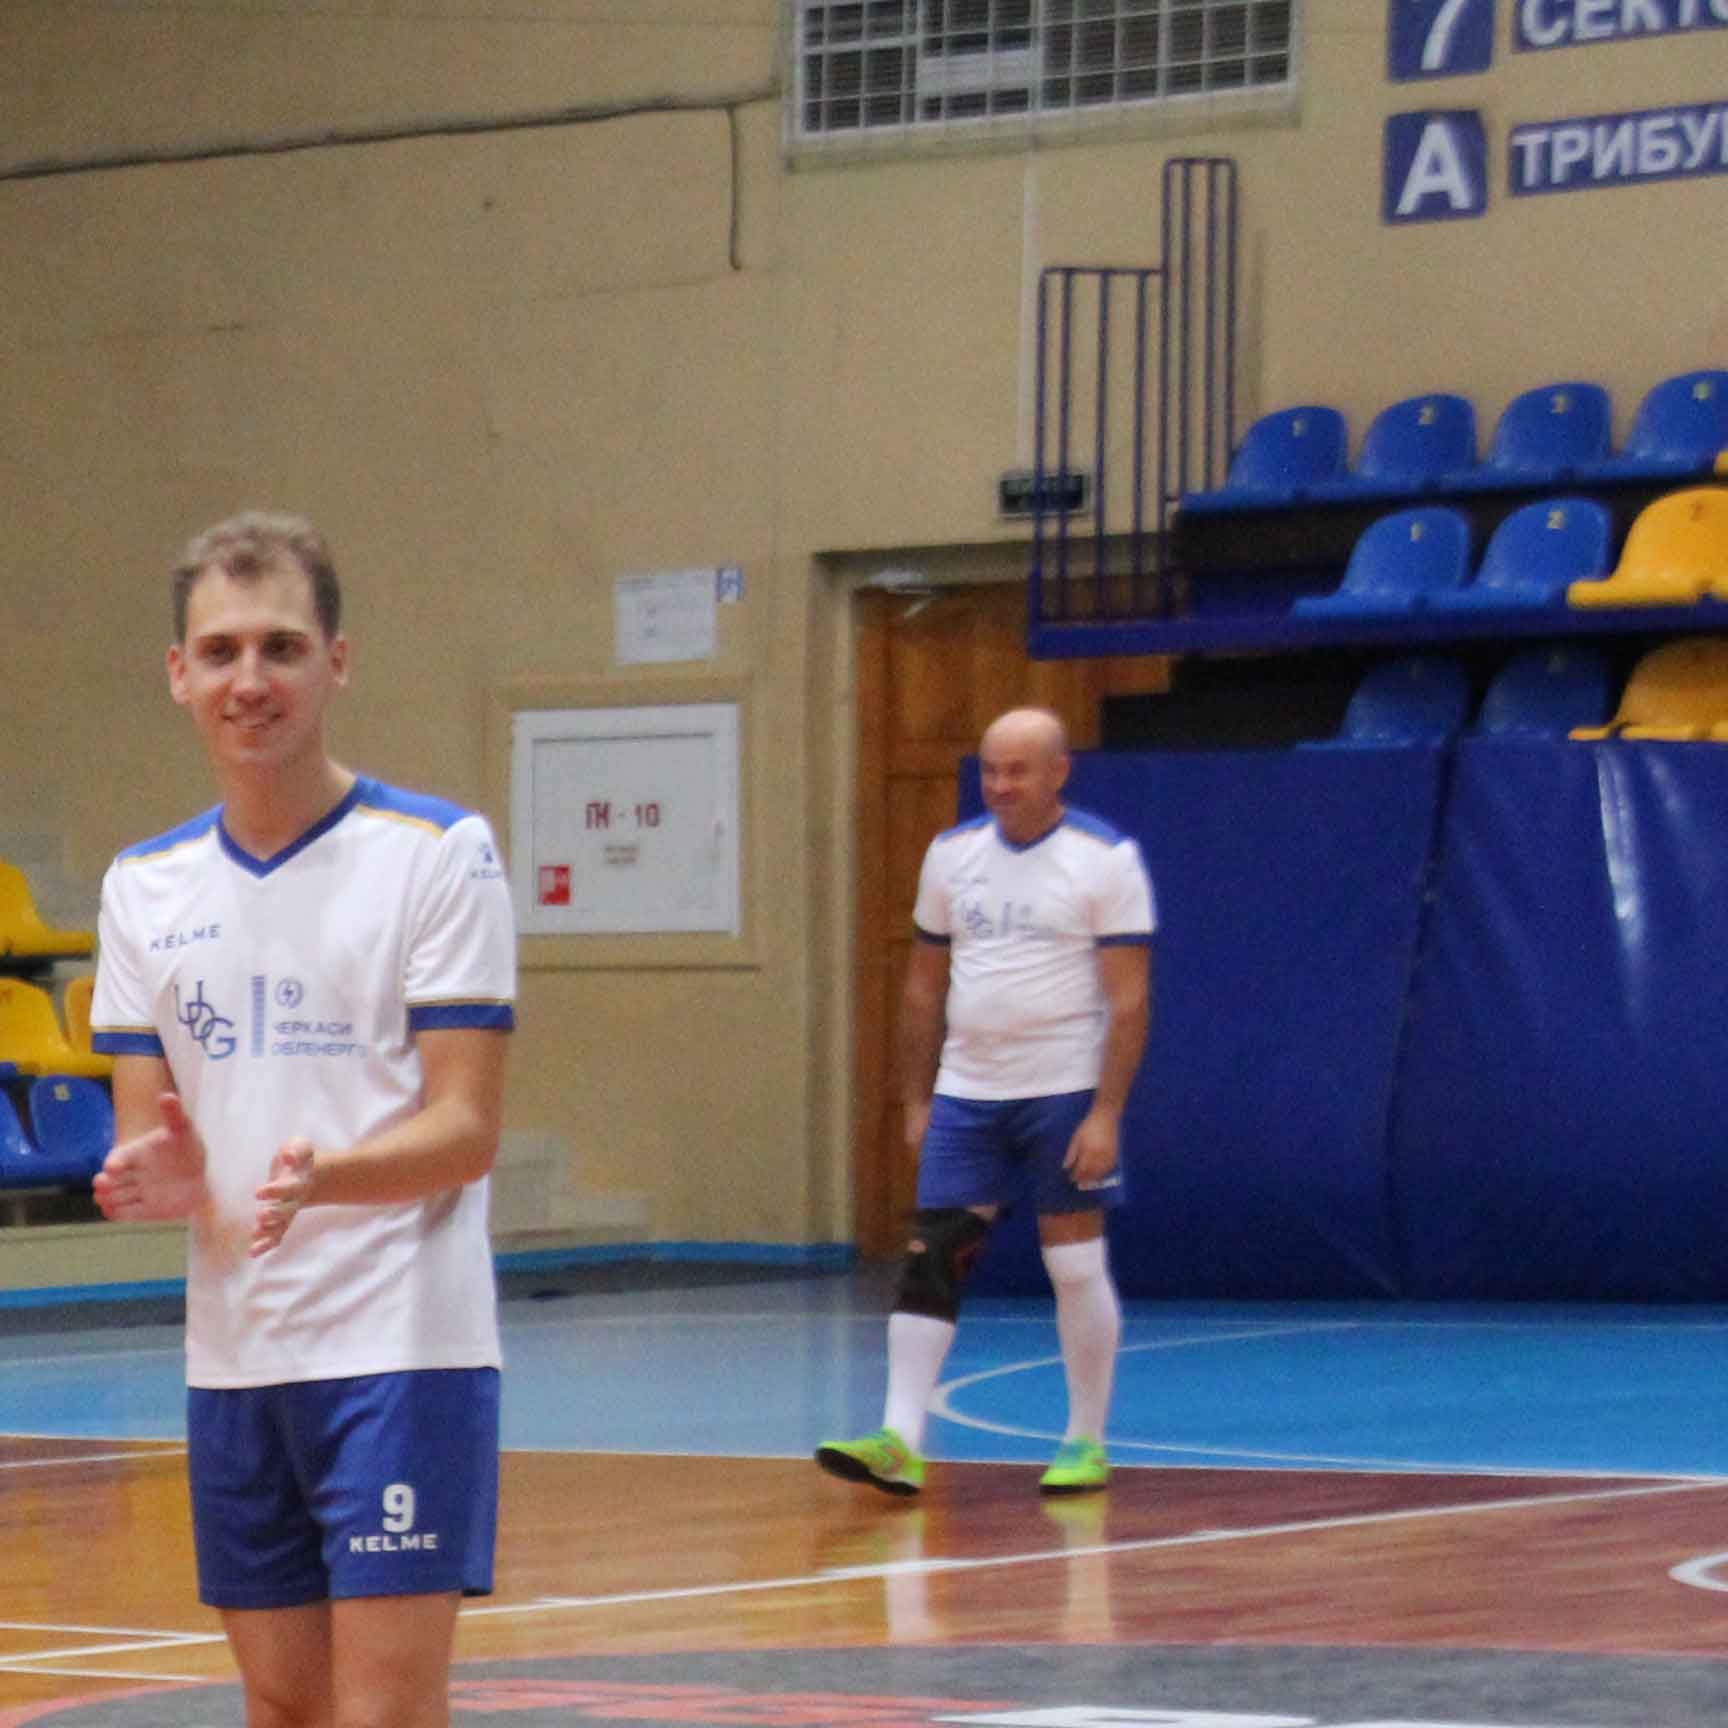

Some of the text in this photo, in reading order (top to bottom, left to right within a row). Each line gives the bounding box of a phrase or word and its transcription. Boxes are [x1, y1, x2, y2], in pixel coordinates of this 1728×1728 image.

[1512, 111, 1728, 188] ТРИБУ
[149, 923, 222, 952] KELME
[382, 1483, 415, 1533] 9
[348, 1533, 439, 1553] KELME
